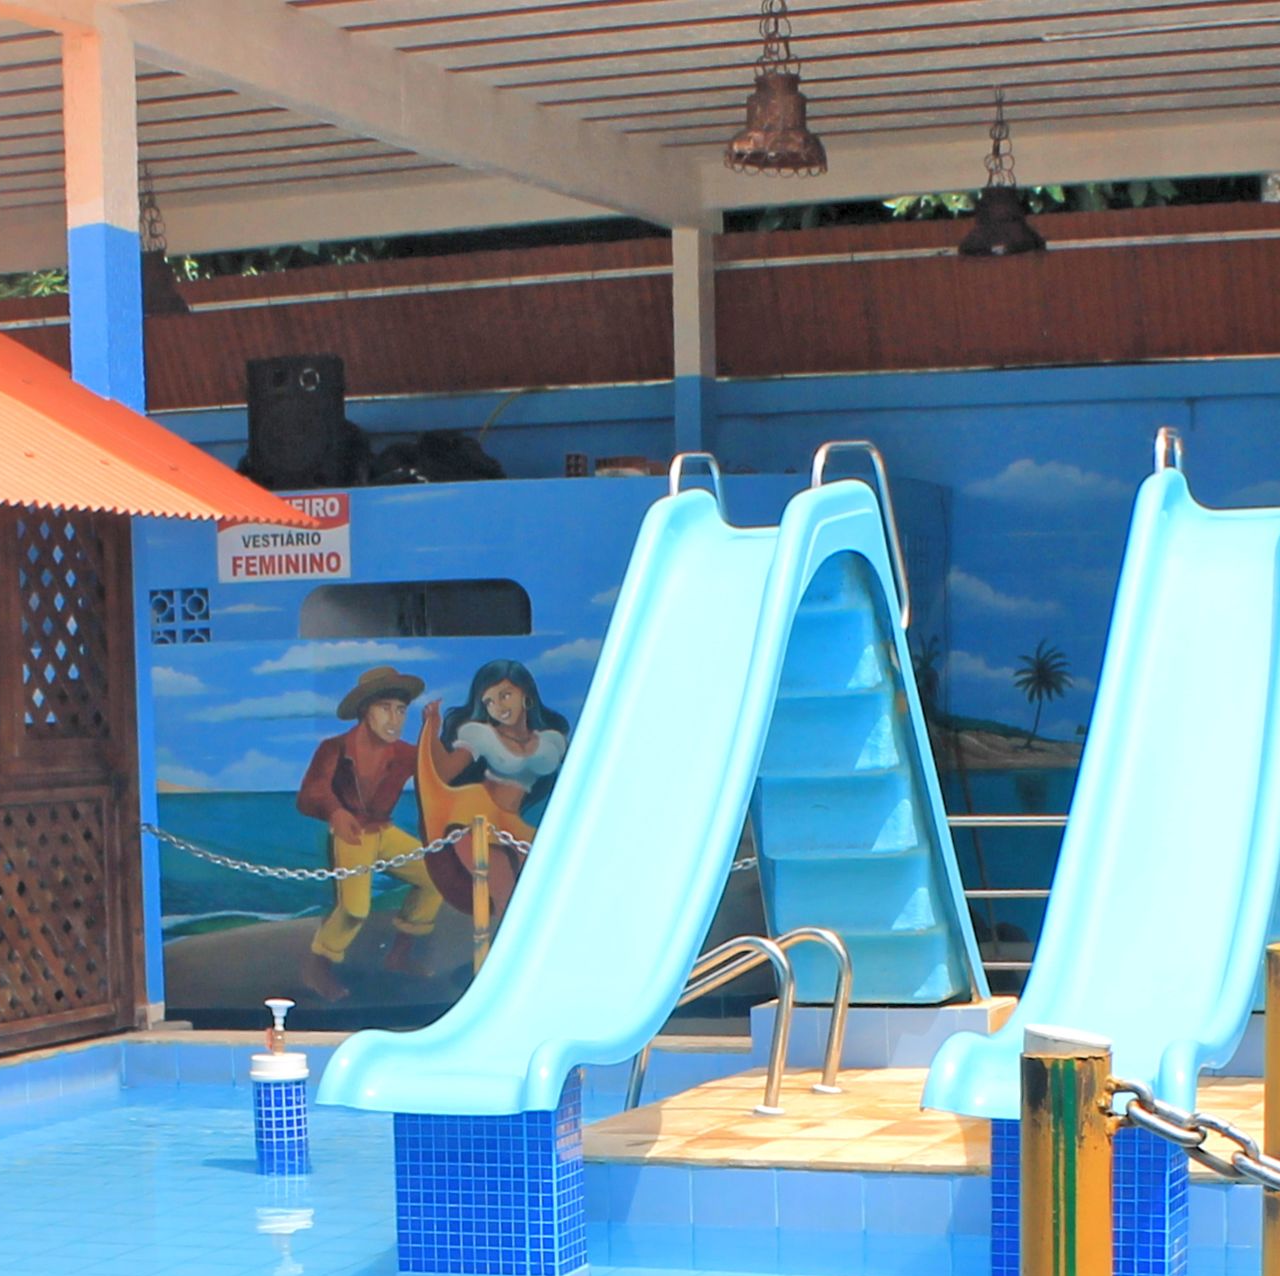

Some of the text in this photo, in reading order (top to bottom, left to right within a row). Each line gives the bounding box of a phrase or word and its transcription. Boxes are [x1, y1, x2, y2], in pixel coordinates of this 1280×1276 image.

[285, 497, 340, 518] EIRO
[241, 531, 322, 549] VESTIÁRIO
[231, 551, 341, 577] FEMININO
